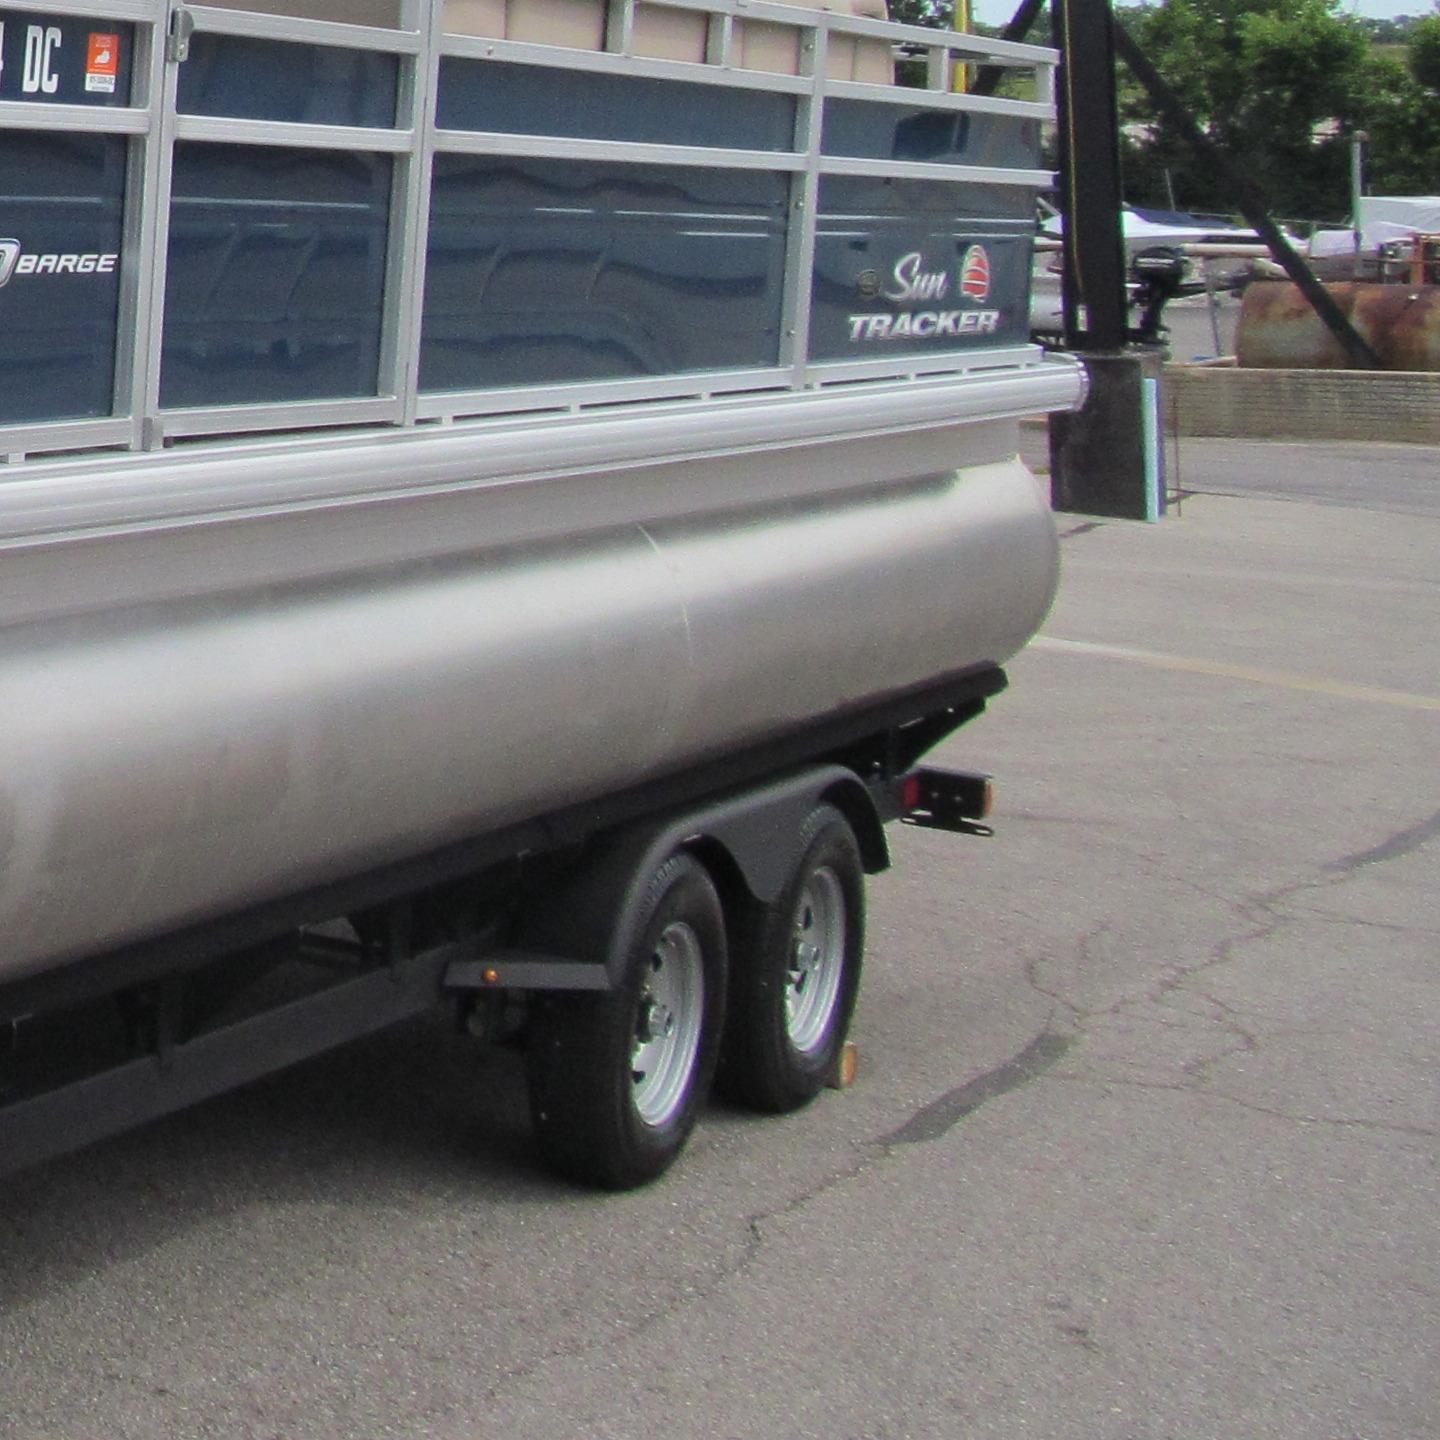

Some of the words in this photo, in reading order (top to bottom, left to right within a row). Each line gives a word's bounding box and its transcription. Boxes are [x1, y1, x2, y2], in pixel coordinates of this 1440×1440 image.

[22, 25, 63, 93] DC
[15, 254, 119, 274] BARGE
[884, 252, 947, 302] Sun
[848, 310, 1000, 342] TRACKER
